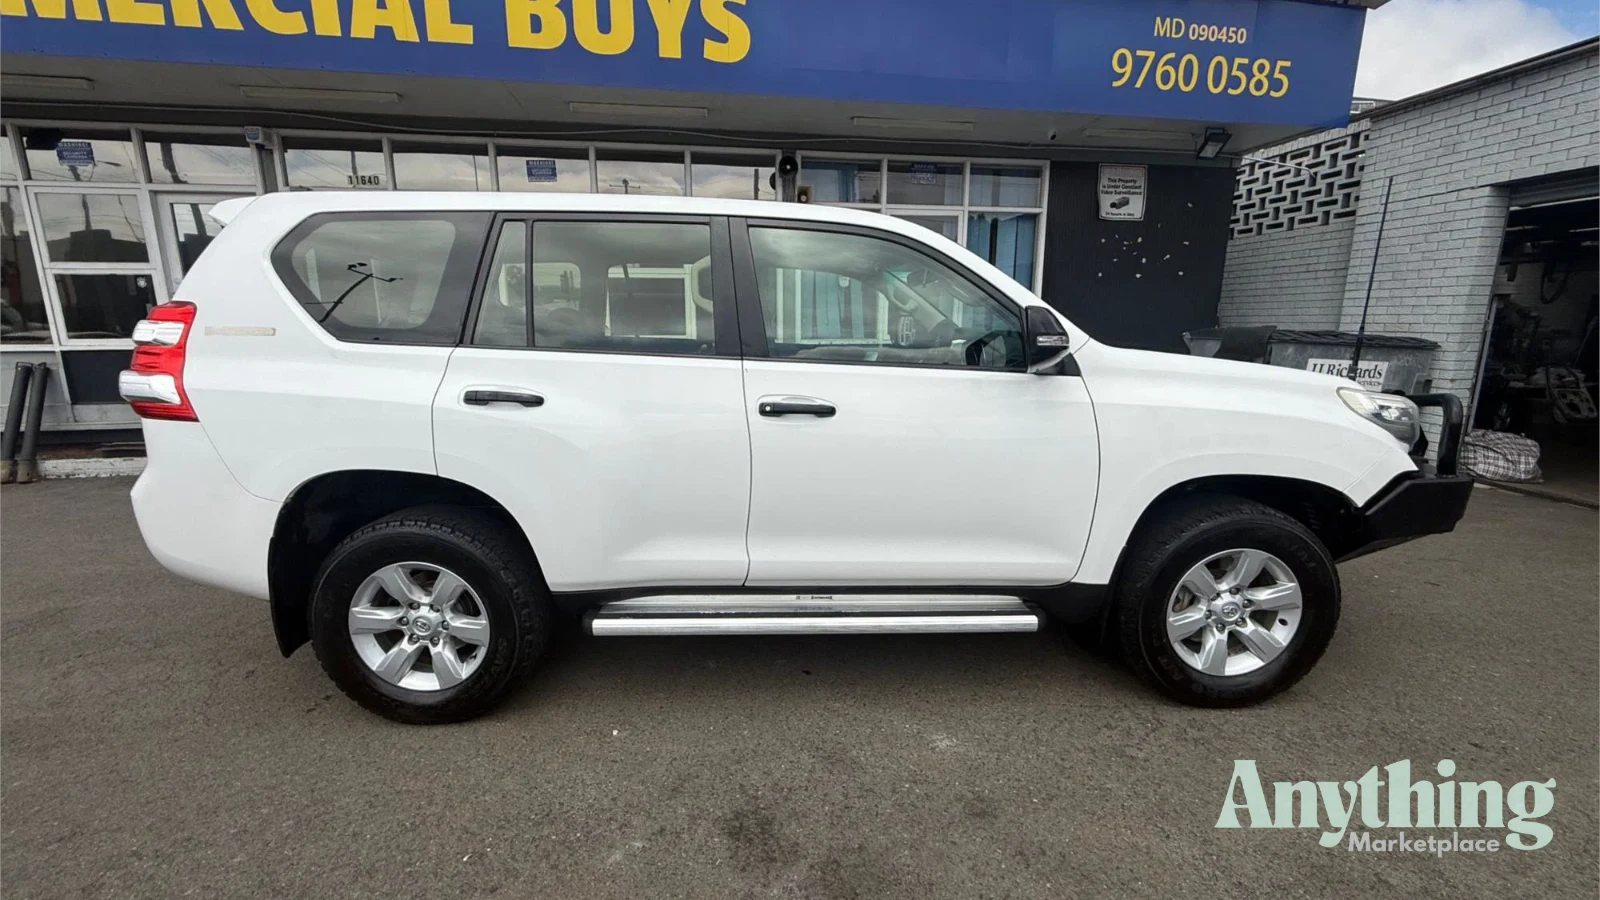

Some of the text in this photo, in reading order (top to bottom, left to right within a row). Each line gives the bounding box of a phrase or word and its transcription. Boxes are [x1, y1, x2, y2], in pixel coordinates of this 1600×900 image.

[505, 0, 752, 64] BUYS
[1153, 16, 1248, 45] MD 090450
[1111, 47, 1293, 98] 9760 0585
[349, 175, 380, 186] 11640
